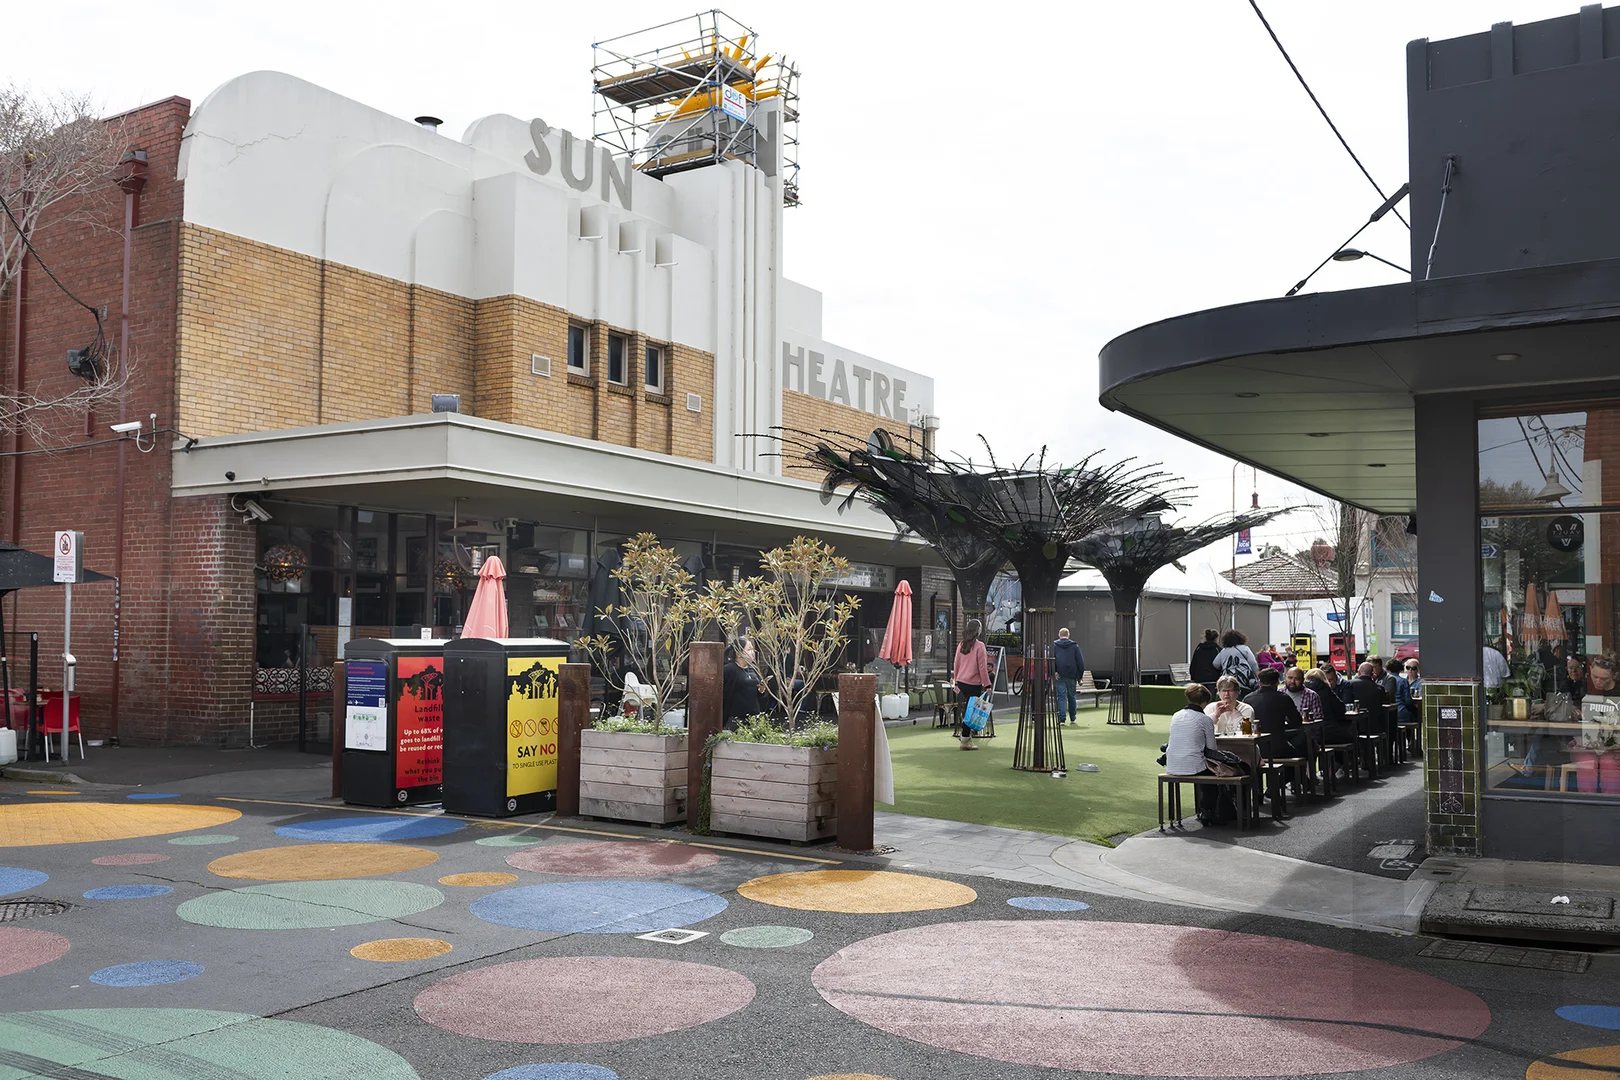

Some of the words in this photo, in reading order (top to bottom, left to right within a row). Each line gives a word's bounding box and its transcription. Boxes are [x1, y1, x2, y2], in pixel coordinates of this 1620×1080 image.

[523, 117, 632, 211] SUN
[414, 704, 443, 712] Landfill
[422, 735, 441, 743] landfill
[518, 745, 538, 758] SAY
[540, 743, 556, 756] NO
